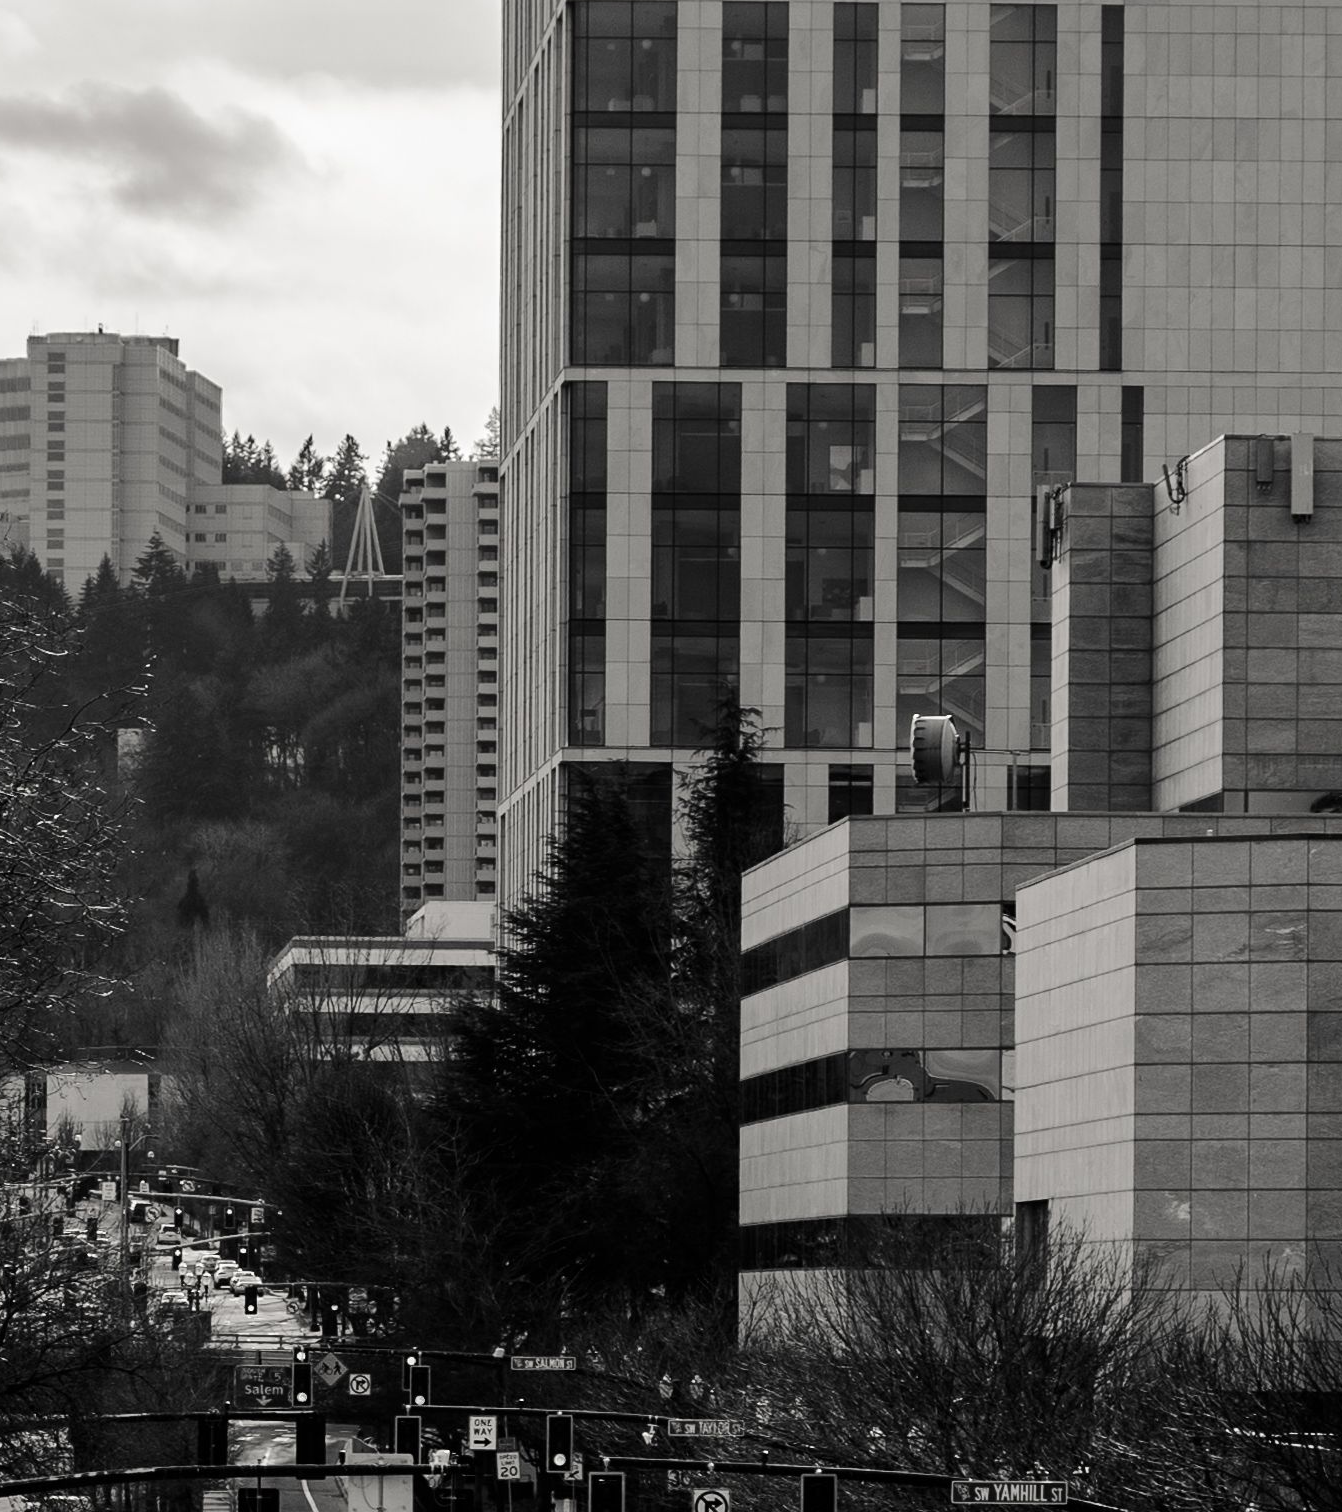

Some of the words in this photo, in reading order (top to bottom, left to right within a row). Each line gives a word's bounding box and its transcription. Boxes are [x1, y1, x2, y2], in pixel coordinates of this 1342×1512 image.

[535, 1358, 565, 1369] SALMON
[245, 1384, 283, 1395] Salem
[474, 1419, 492, 1427] ONE
[474, 1428, 493, 1436] WAY
[500, 1466, 517, 1477] 20
[974, 1487, 989, 1501] SW
[994, 1484, 1048, 1502] YAMHILL
[1051, 1488, 1064, 1502] ST
